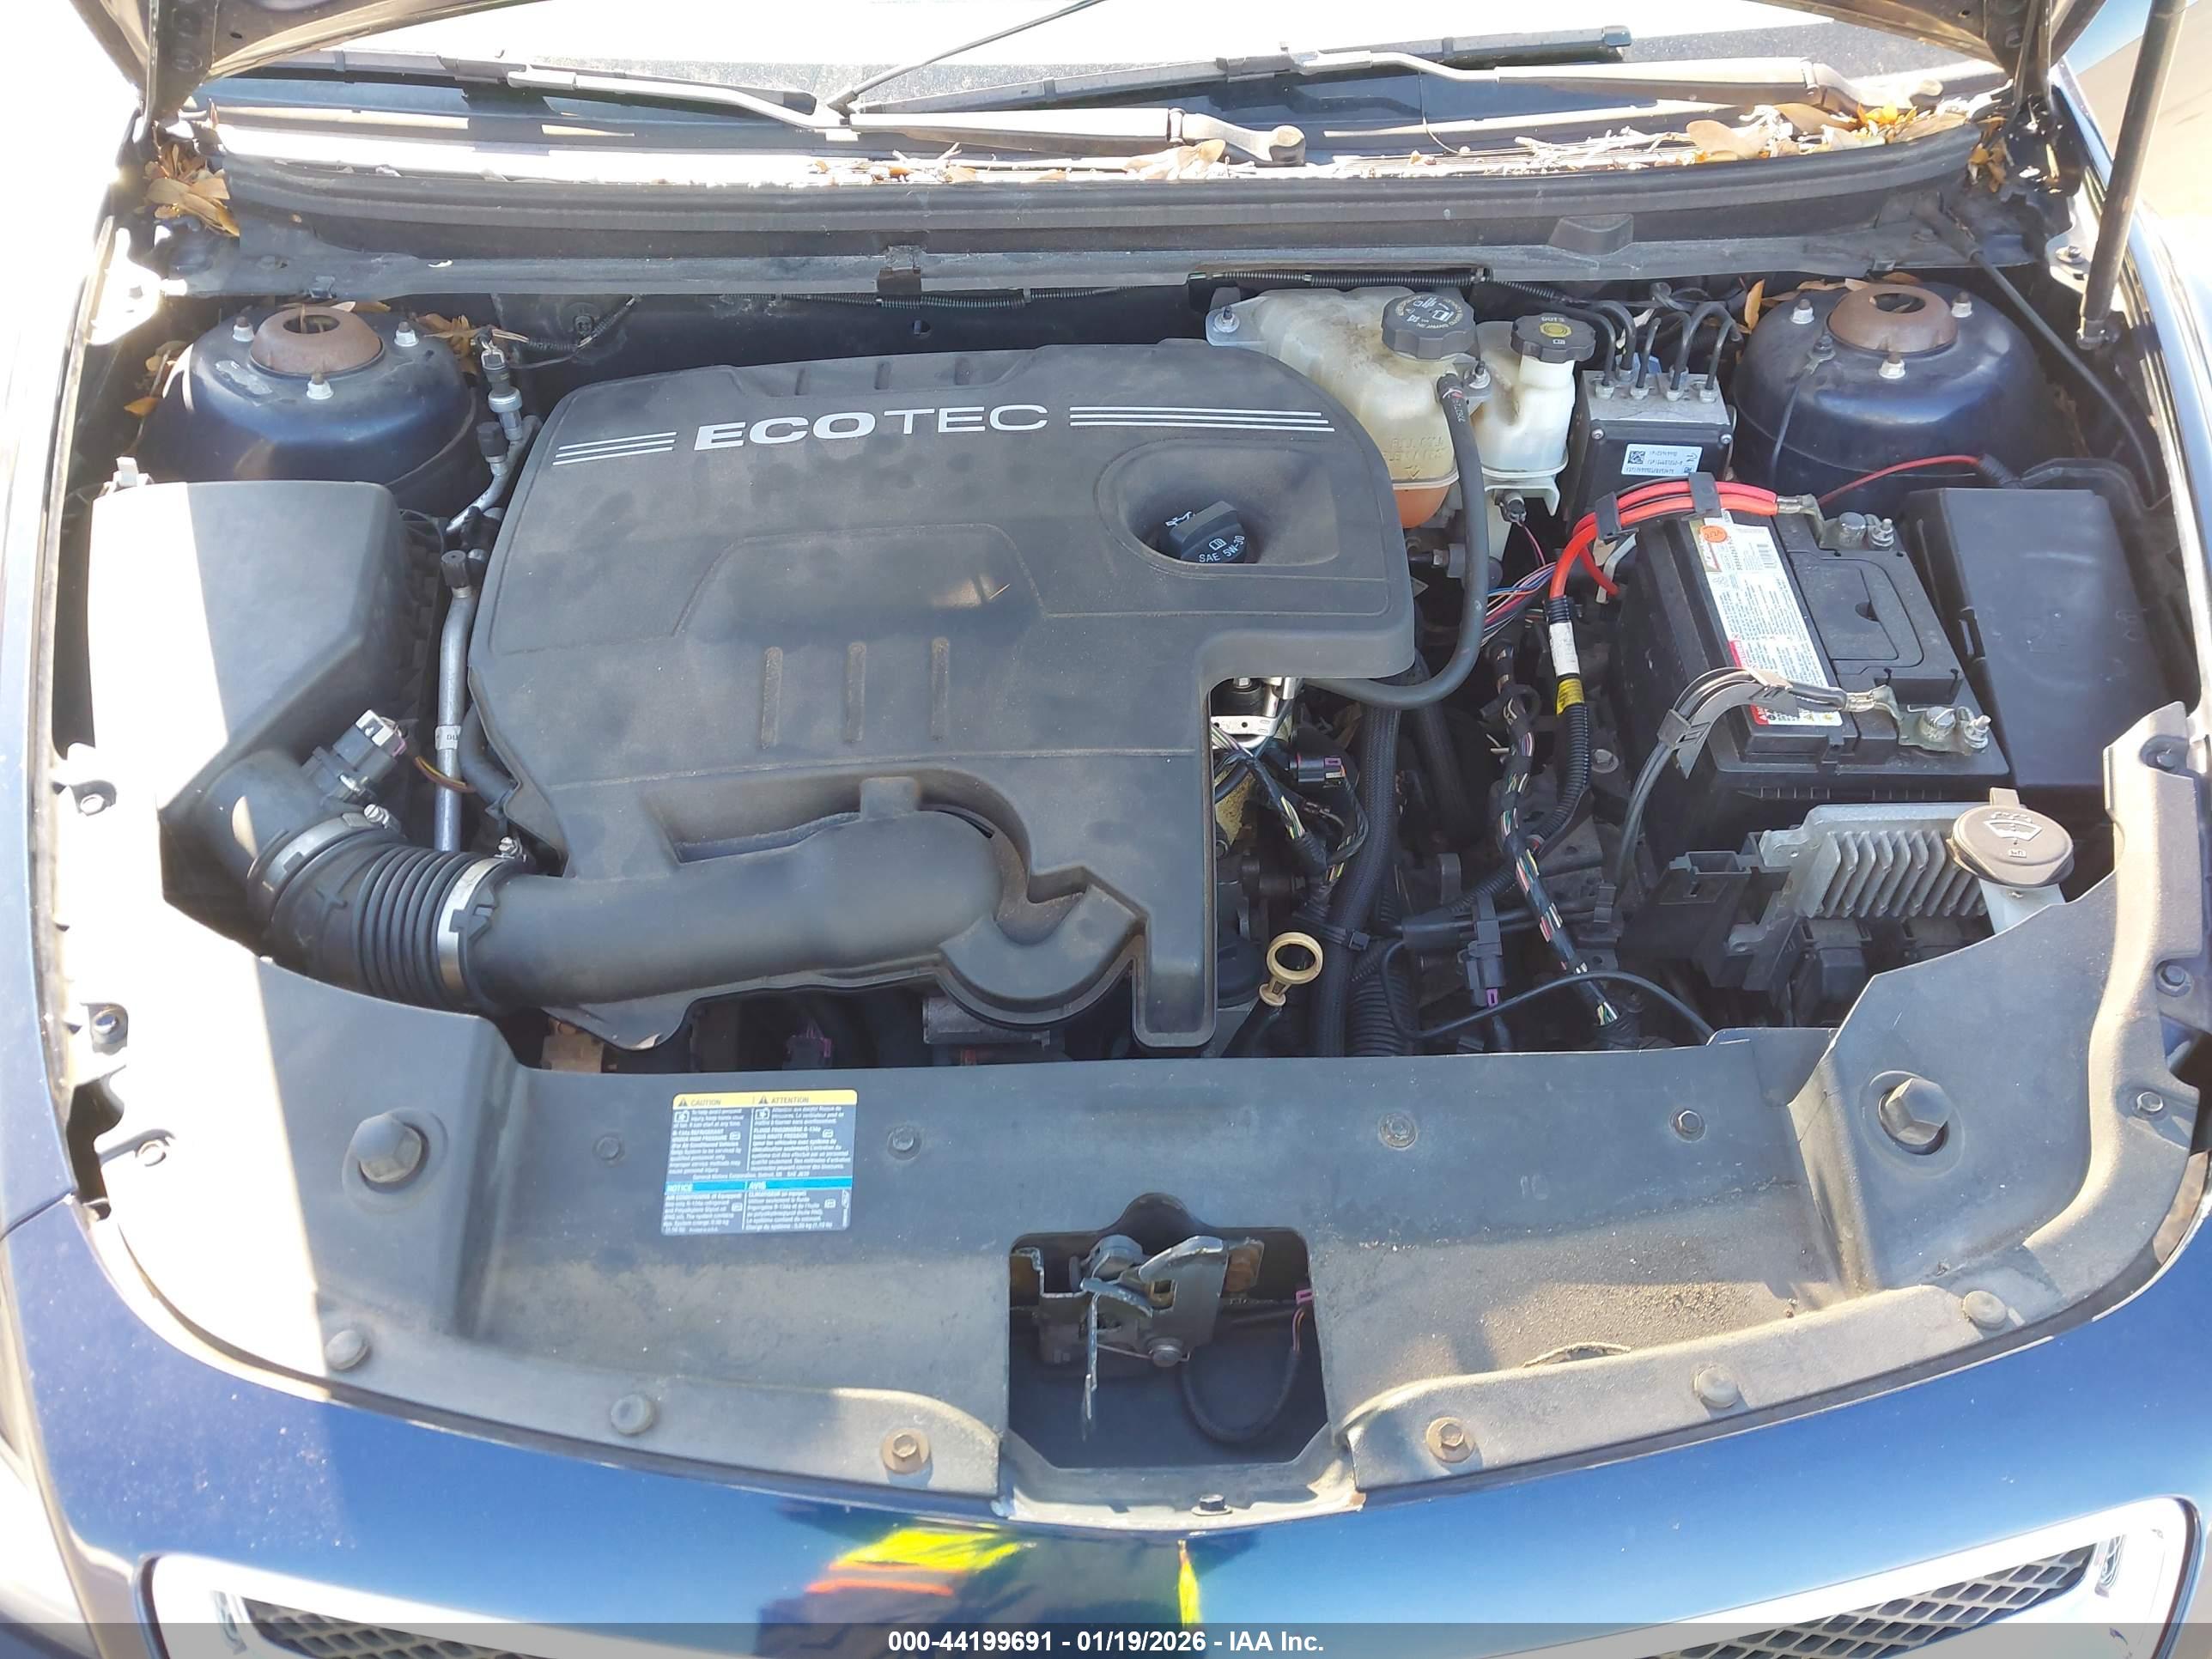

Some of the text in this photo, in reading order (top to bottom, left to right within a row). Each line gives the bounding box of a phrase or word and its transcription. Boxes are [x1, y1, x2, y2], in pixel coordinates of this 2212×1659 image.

[693, 404, 1048, 451] ECOTEC
[1199, 535, 1245, 563] SAE 5W-30
